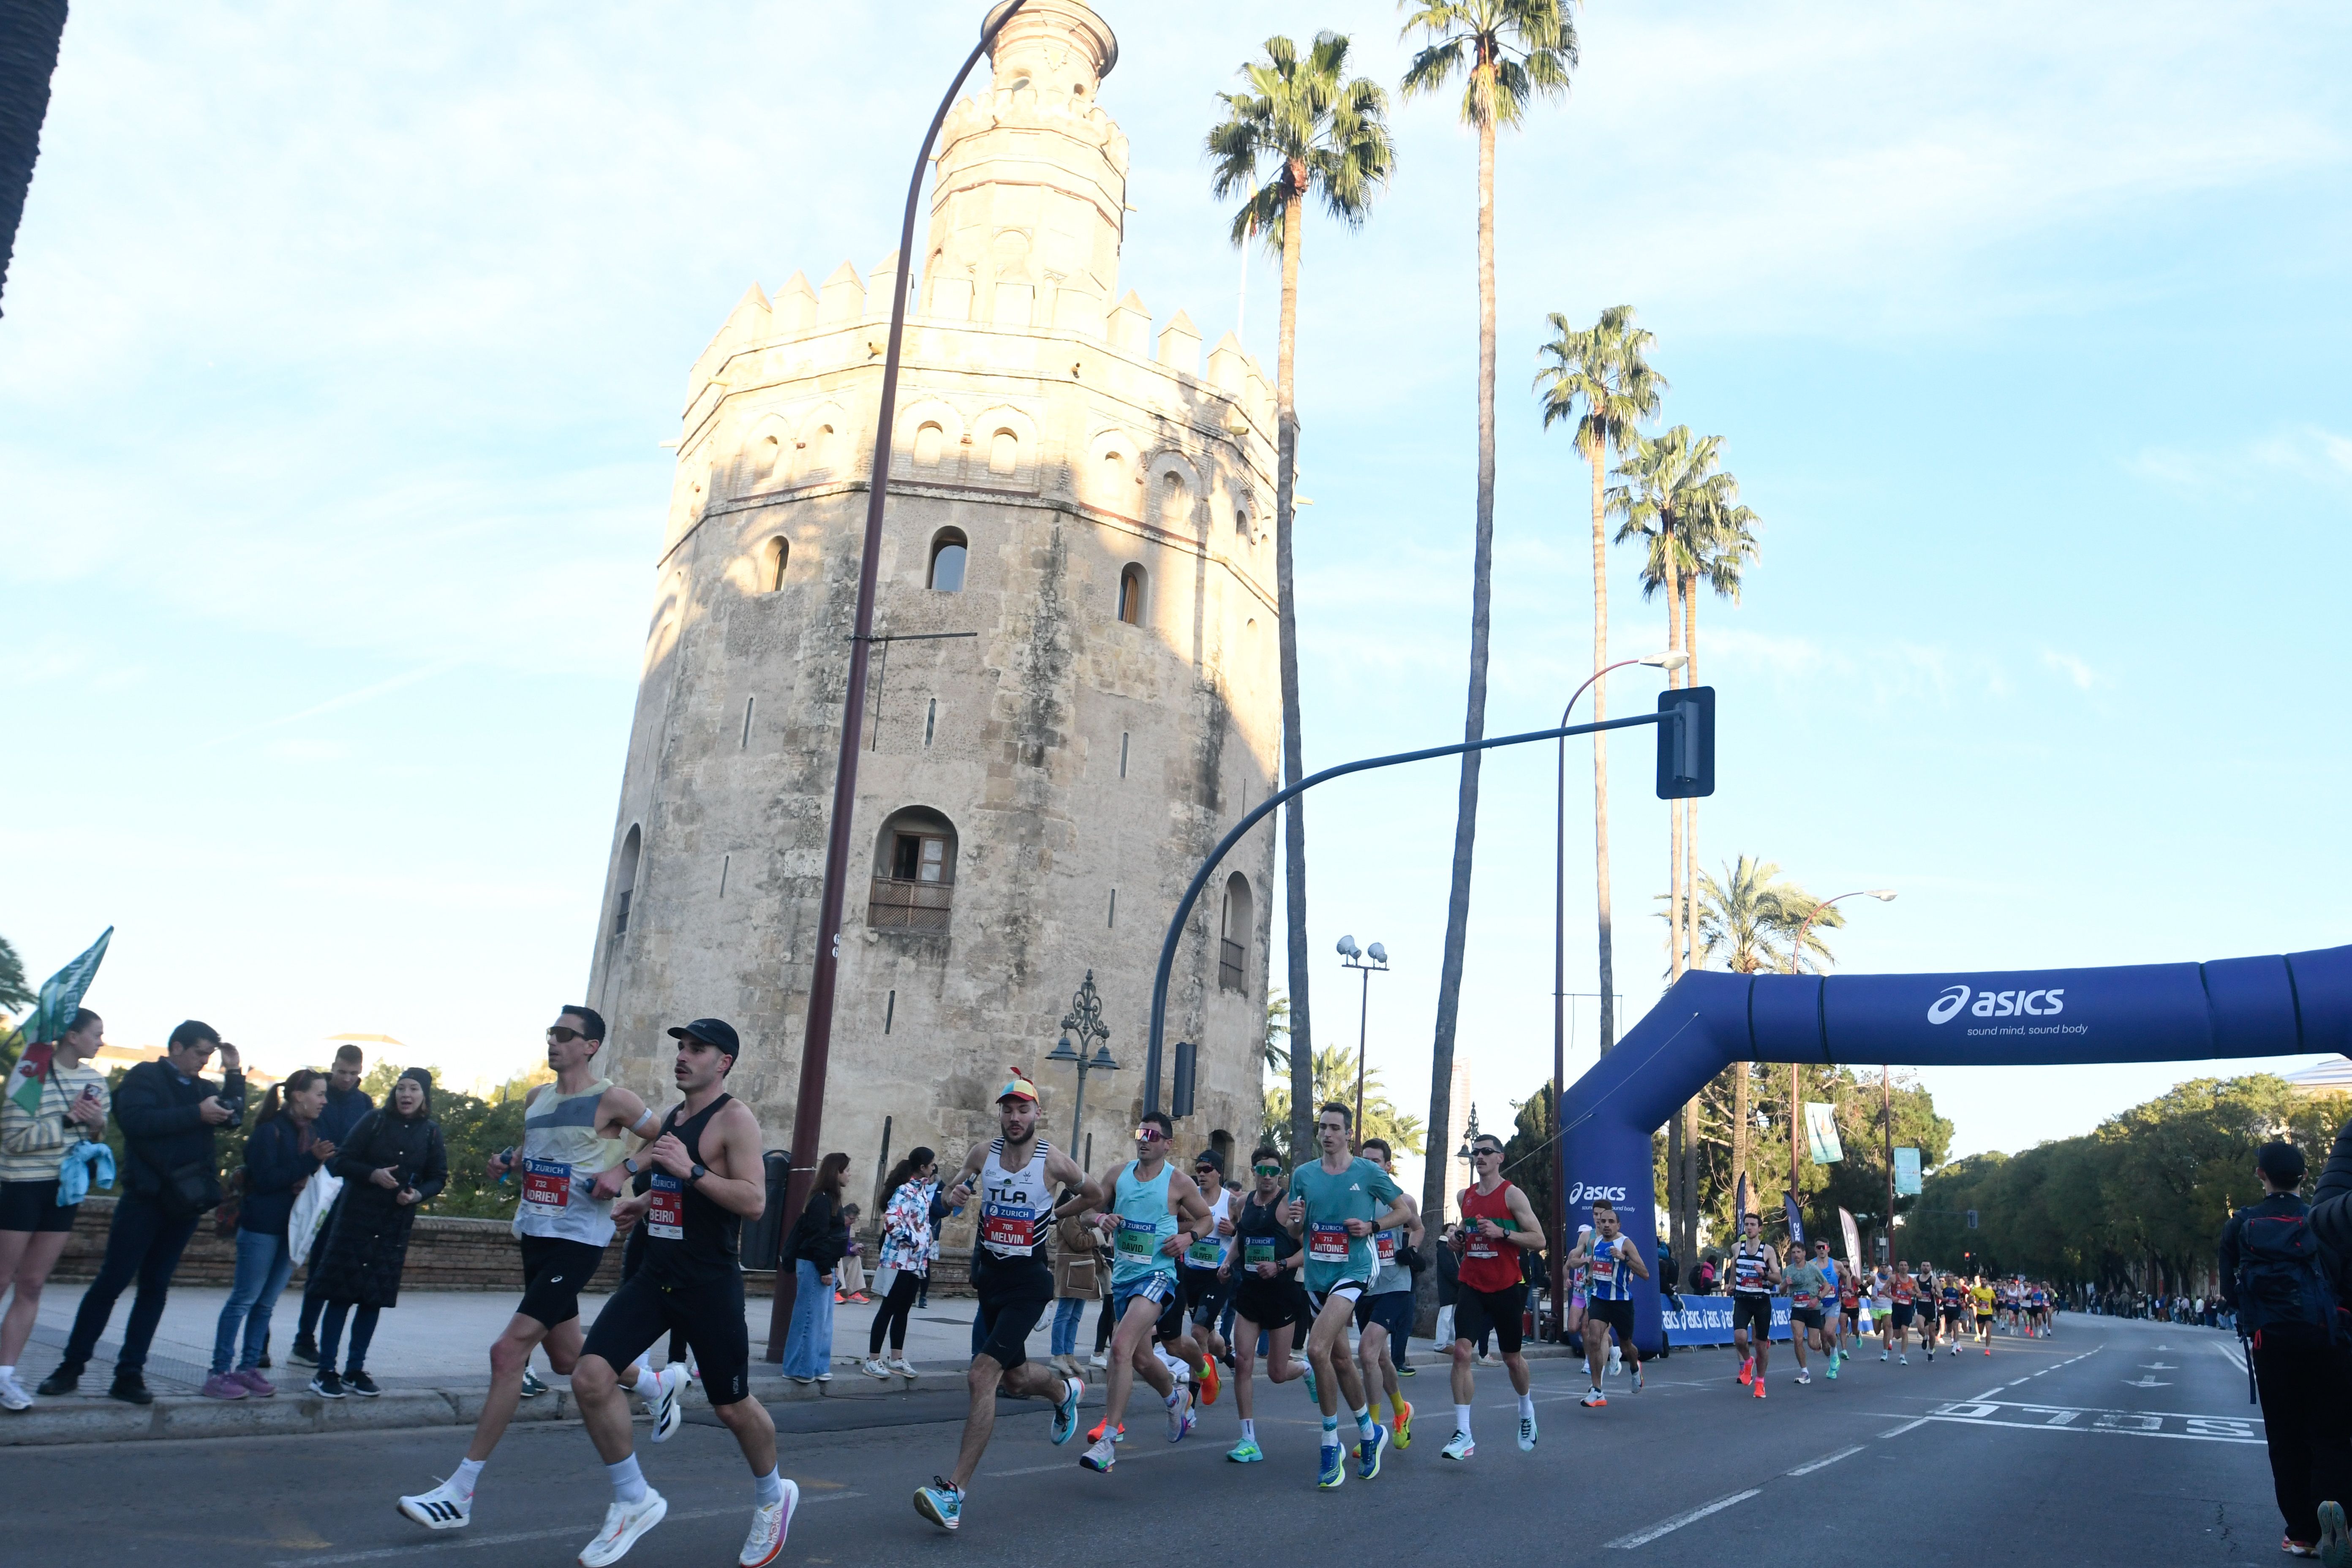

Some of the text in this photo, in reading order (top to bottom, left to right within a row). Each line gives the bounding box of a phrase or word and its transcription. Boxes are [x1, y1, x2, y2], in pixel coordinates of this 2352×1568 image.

[63, 960, 82, 1024] UNNERS
[1972, 989, 2064, 1016] asics
[1967, 1024, 2088, 1035] sound mind, sound body
[534, 1165, 564, 1174] ZURICH
[535, 1180, 547, 1188] 732
[988, 1187, 1026, 1203] TLA
[1584, 1186, 1626, 1201] asics
[649, 1208, 674, 1223] BEIRO
[1001, 1209, 1029, 1217] ZURICH
[991, 1231, 1024, 1244] MELVIN
[1122, 1241, 1143, 1253] DAVID
[1314, 1243, 1344, 1253] ANTOINE
[1193, 1251, 1212, 1260] OLIVER
[1378, 1250, 1394, 1258] TIAN
[1686, 1310, 1702, 1328] asics
[767, 1509, 782, 1545] HOKA
